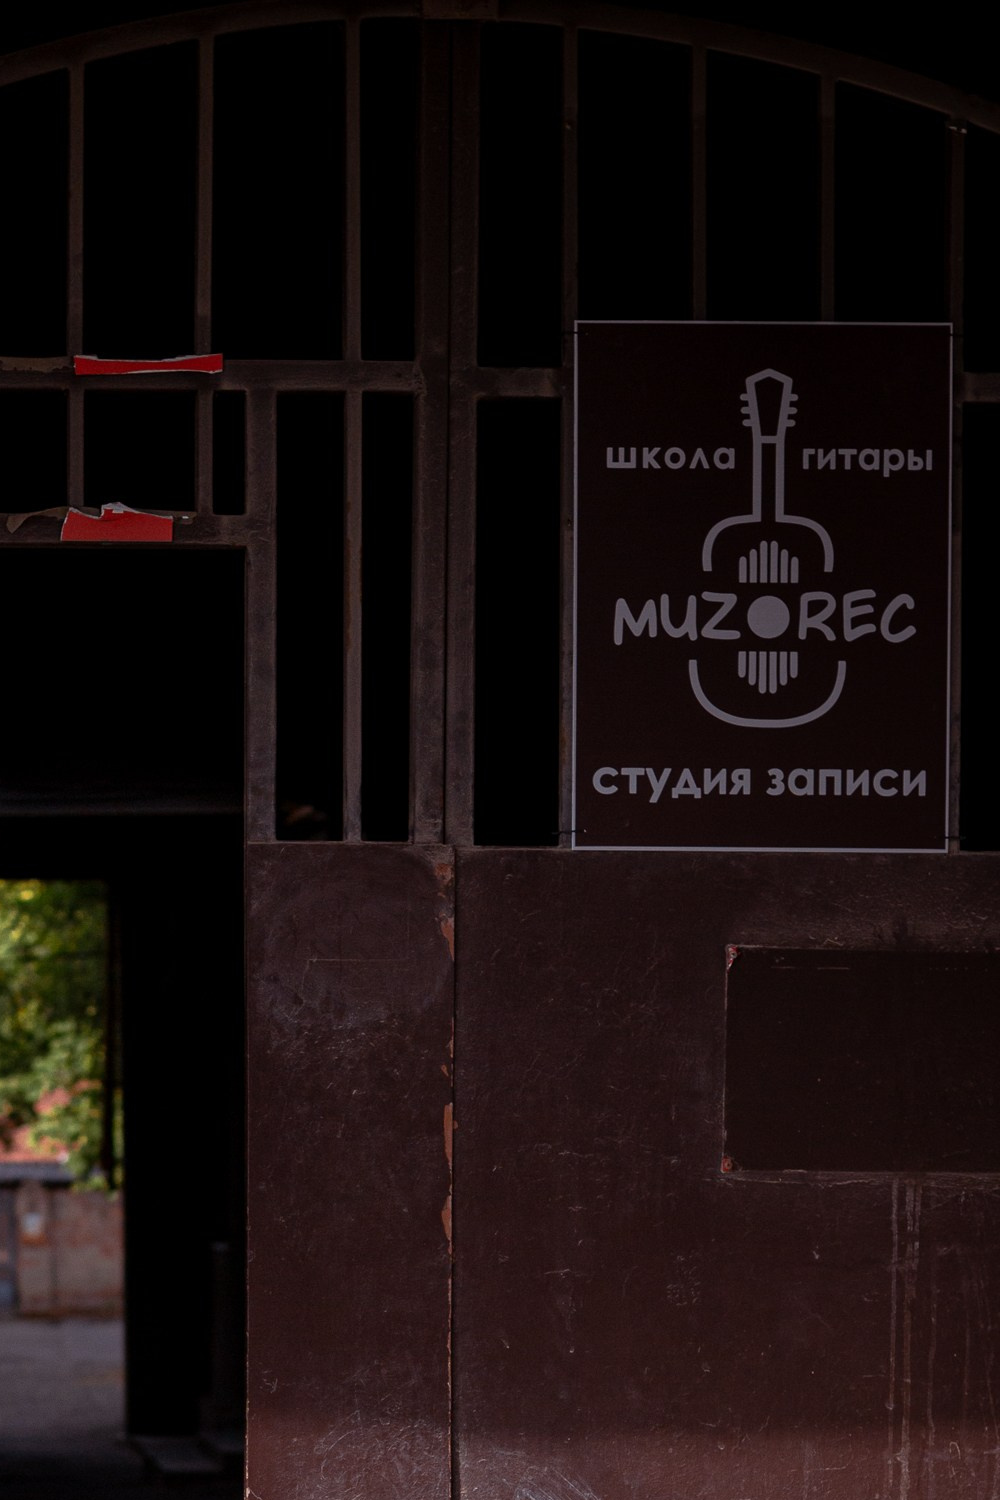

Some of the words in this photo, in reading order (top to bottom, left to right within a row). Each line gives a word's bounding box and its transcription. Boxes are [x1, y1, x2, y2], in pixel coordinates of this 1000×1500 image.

[606, 445, 736, 470] школа
[803, 447, 933, 477] гитары
[592, 766, 752, 803] студия
[766, 767, 927, 797] записи
